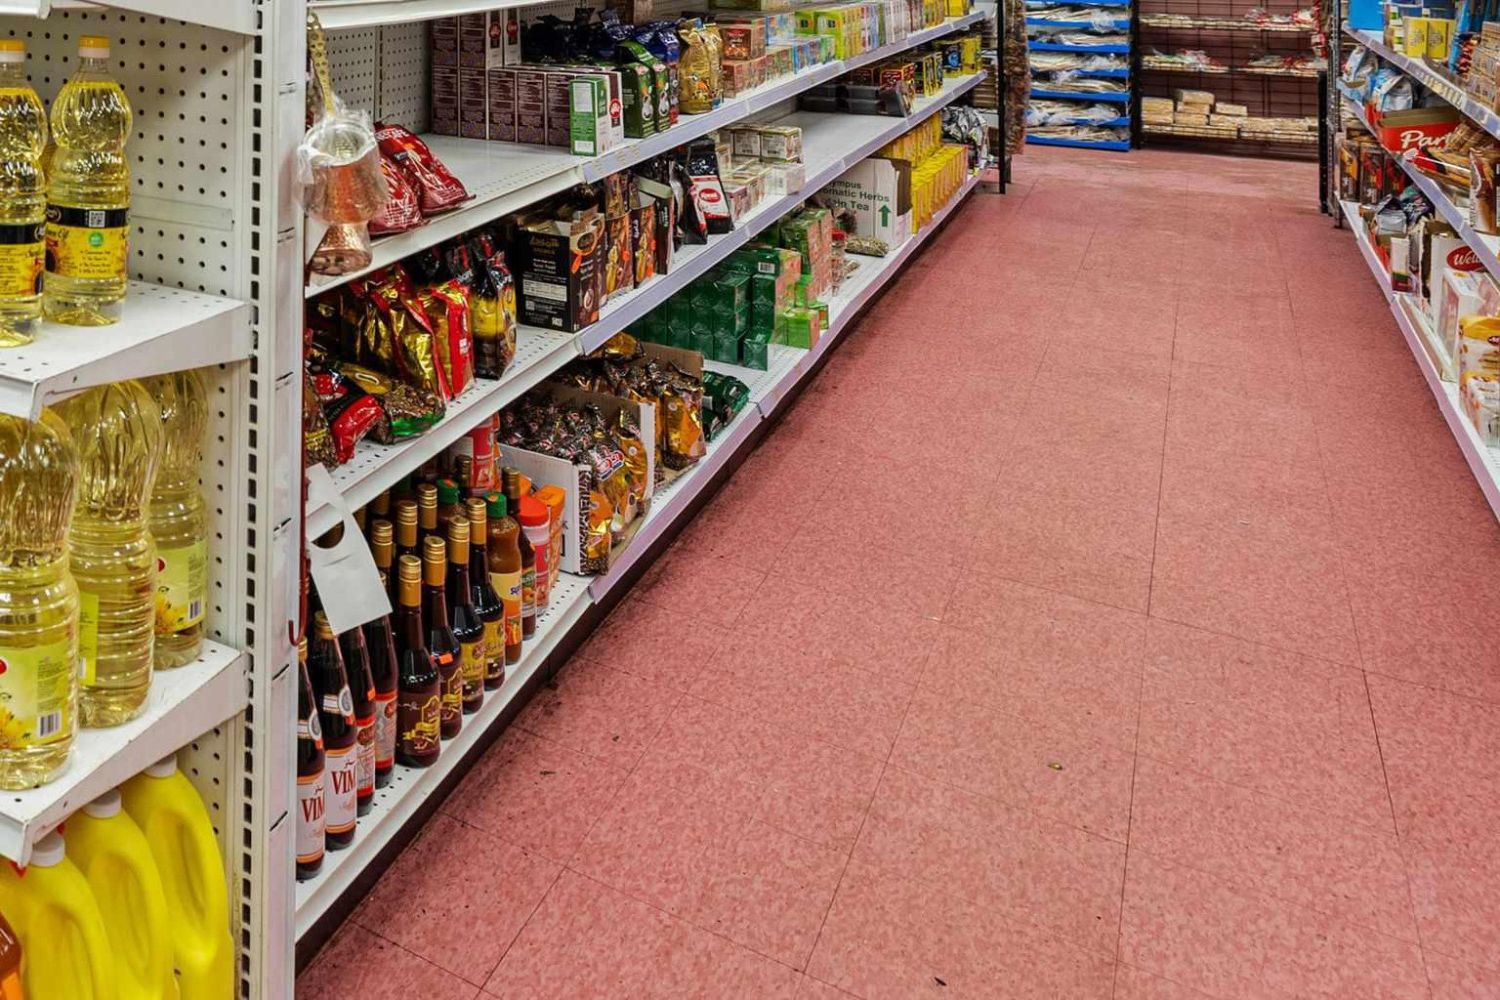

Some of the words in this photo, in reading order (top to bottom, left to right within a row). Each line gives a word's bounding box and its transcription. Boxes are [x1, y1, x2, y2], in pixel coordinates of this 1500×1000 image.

[828, 180, 862, 190] ympus
[821, 187, 856, 198] omatic
[858, 191, 890, 203] Herbs
[849, 201, 869, 212] Tea
[331, 769, 356, 795] VIM
[301, 795, 325, 823] VIM
